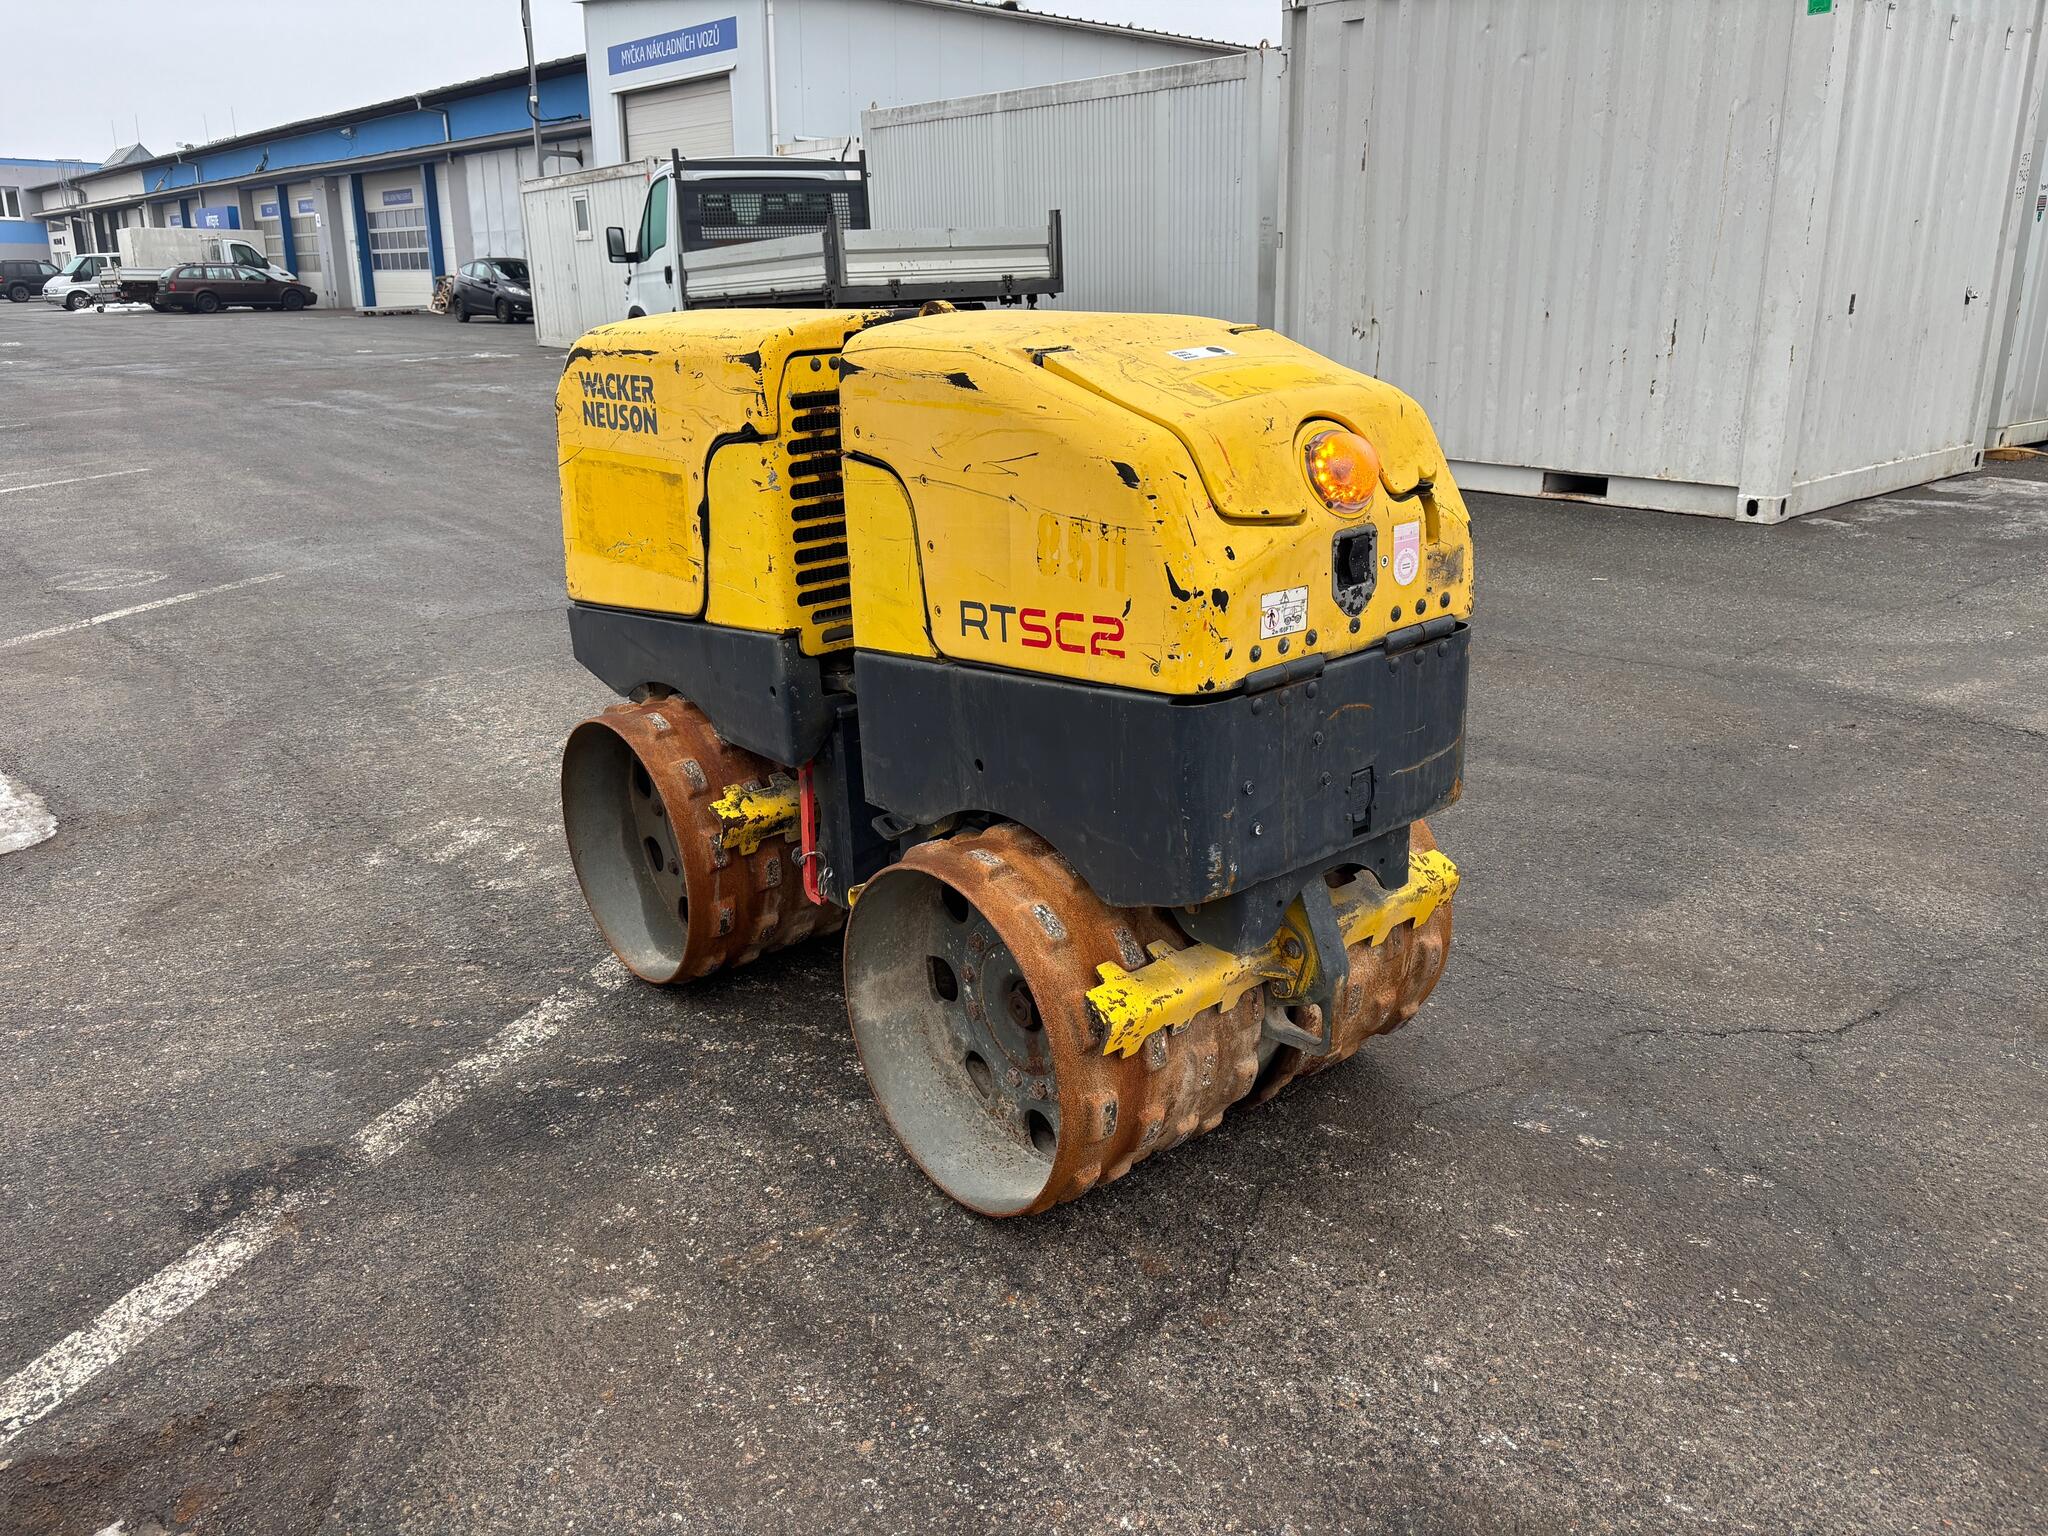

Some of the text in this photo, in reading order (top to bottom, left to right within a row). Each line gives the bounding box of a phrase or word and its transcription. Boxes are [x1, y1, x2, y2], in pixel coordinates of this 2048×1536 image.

[621, 24, 720, 66] MYČKA NÁKLADNÍCH VOZŮ
[579, 371, 656, 403] WACKER
[582, 401, 659, 435] NEUSON
